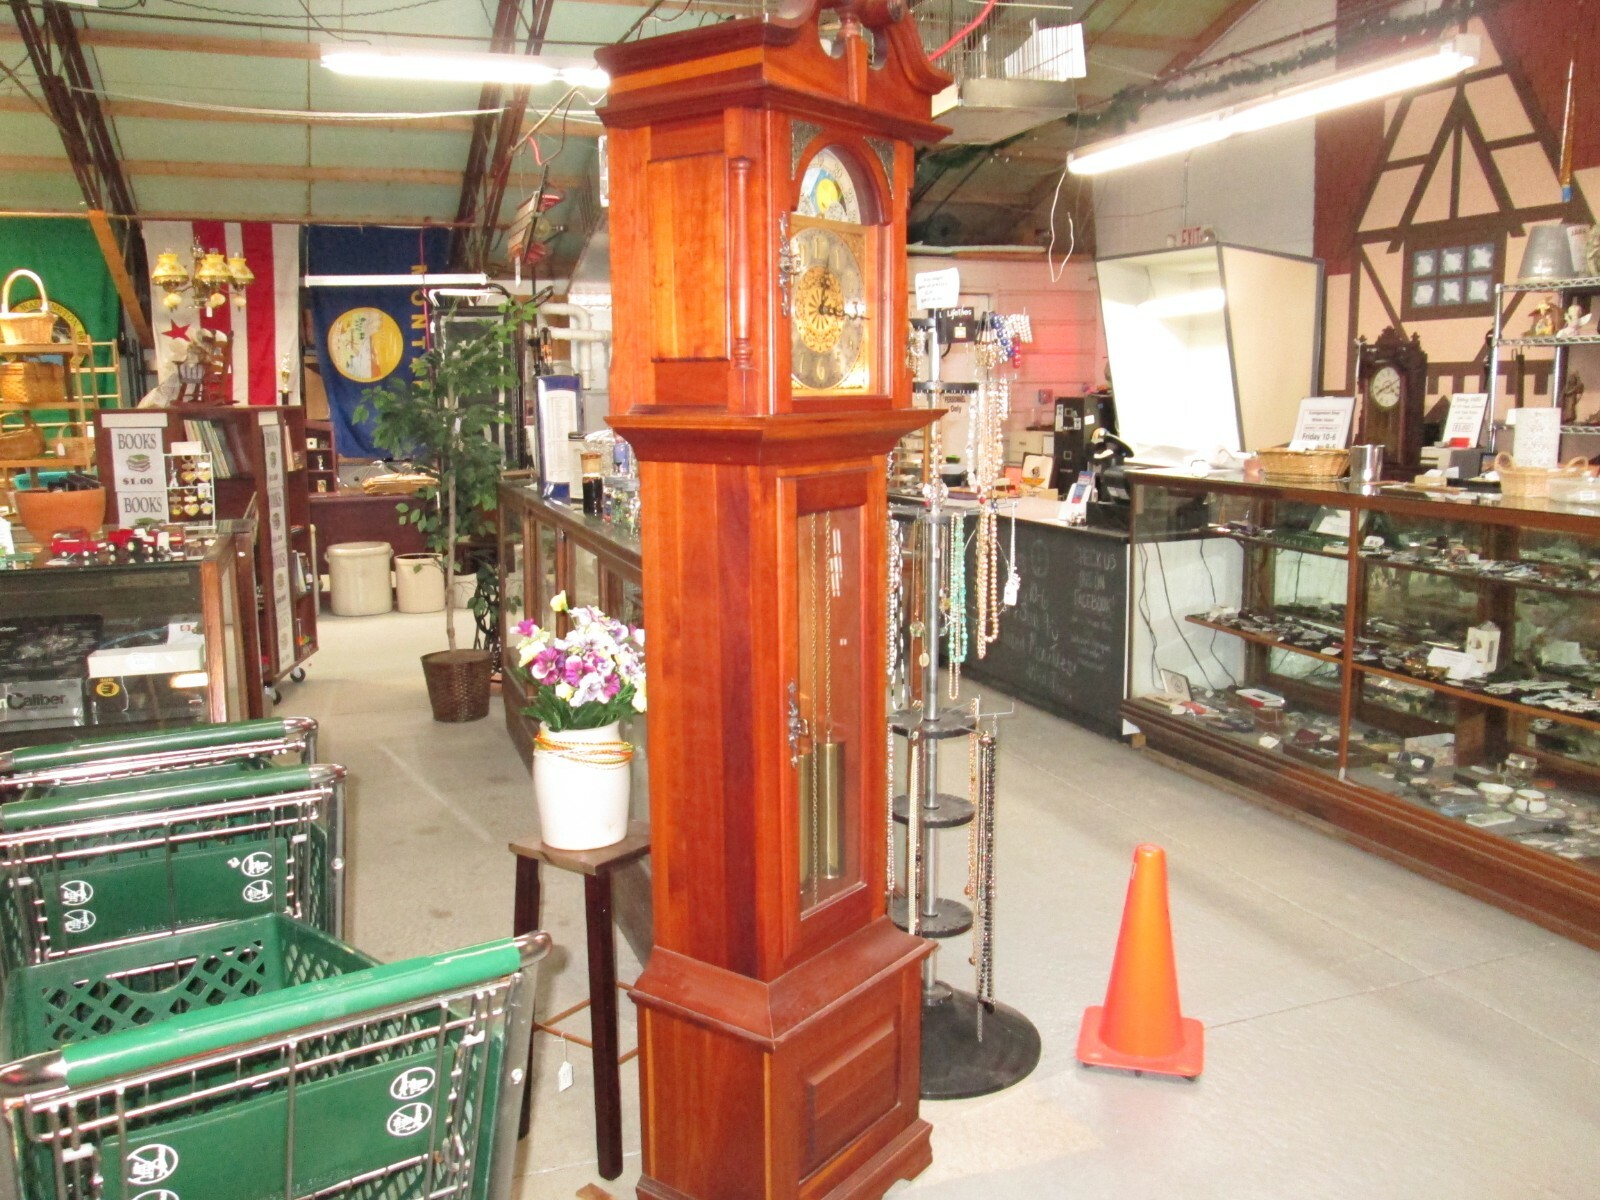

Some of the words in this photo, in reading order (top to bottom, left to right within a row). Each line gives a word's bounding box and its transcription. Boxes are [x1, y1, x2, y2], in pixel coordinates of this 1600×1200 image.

[1181, 226, 1201, 246] EXIT
[117, 433, 157, 450] BOOKS
[1302, 432, 1320, 441] Friday
[1322, 433, 1337, 441] 10-6
[122, 477, 154, 486] $1.00
[123, 496, 163, 514] BOOKS
[7, 692, 66, 710] Caliber
